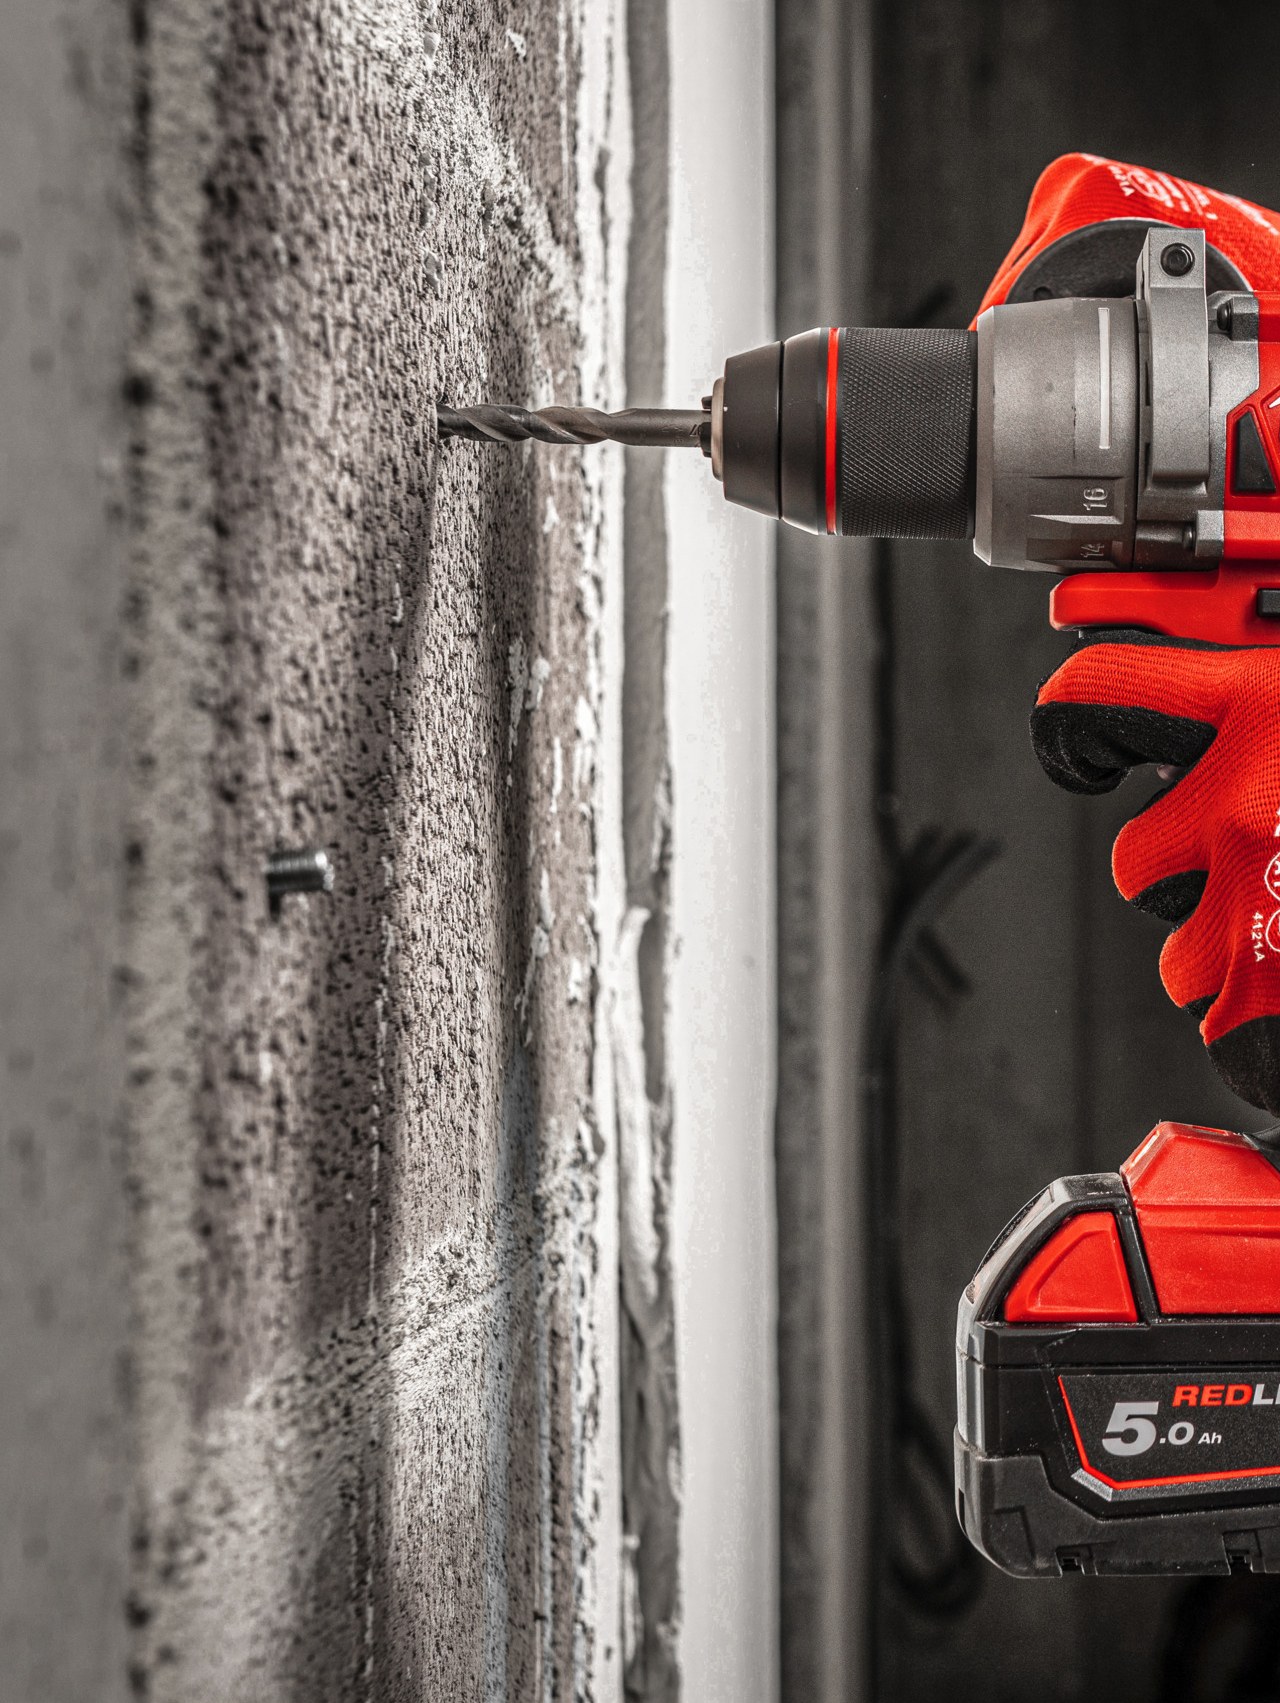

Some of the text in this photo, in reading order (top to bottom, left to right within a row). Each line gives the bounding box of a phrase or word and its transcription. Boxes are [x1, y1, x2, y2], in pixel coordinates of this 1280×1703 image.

[1082, 487, 1108, 511] 16
[1101, 1401, 1223, 1456] 5.0 Ah
